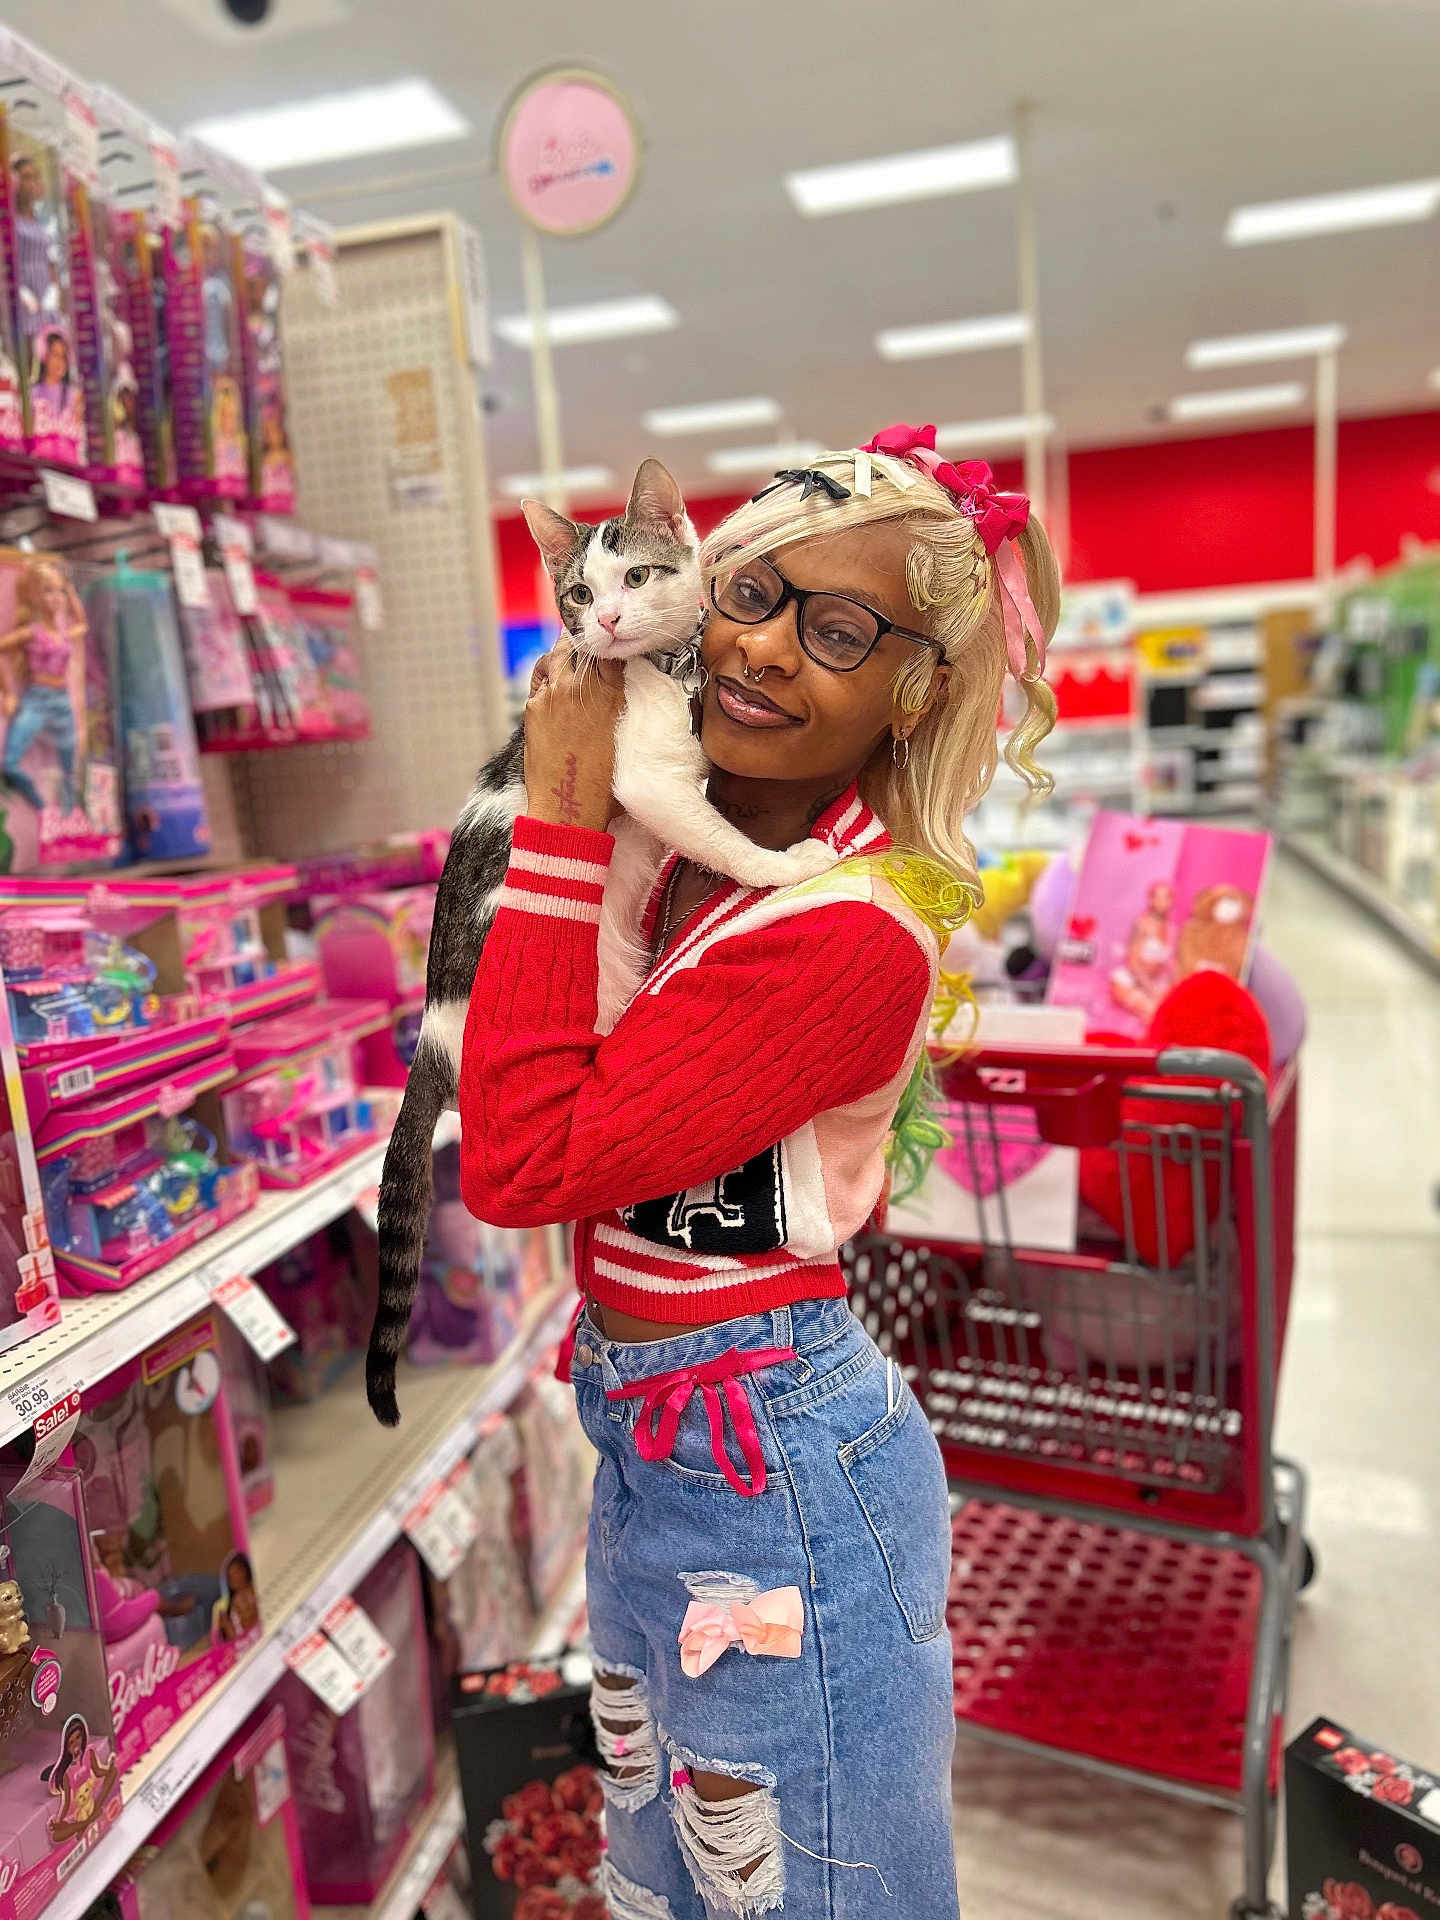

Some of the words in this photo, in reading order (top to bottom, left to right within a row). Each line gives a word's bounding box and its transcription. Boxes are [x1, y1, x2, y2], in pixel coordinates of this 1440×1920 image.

[15, 1388, 49, 1417] 30.99
[35, 1400, 69, 1438] Sale!
[108, 1643, 180, 1734] Barbie
